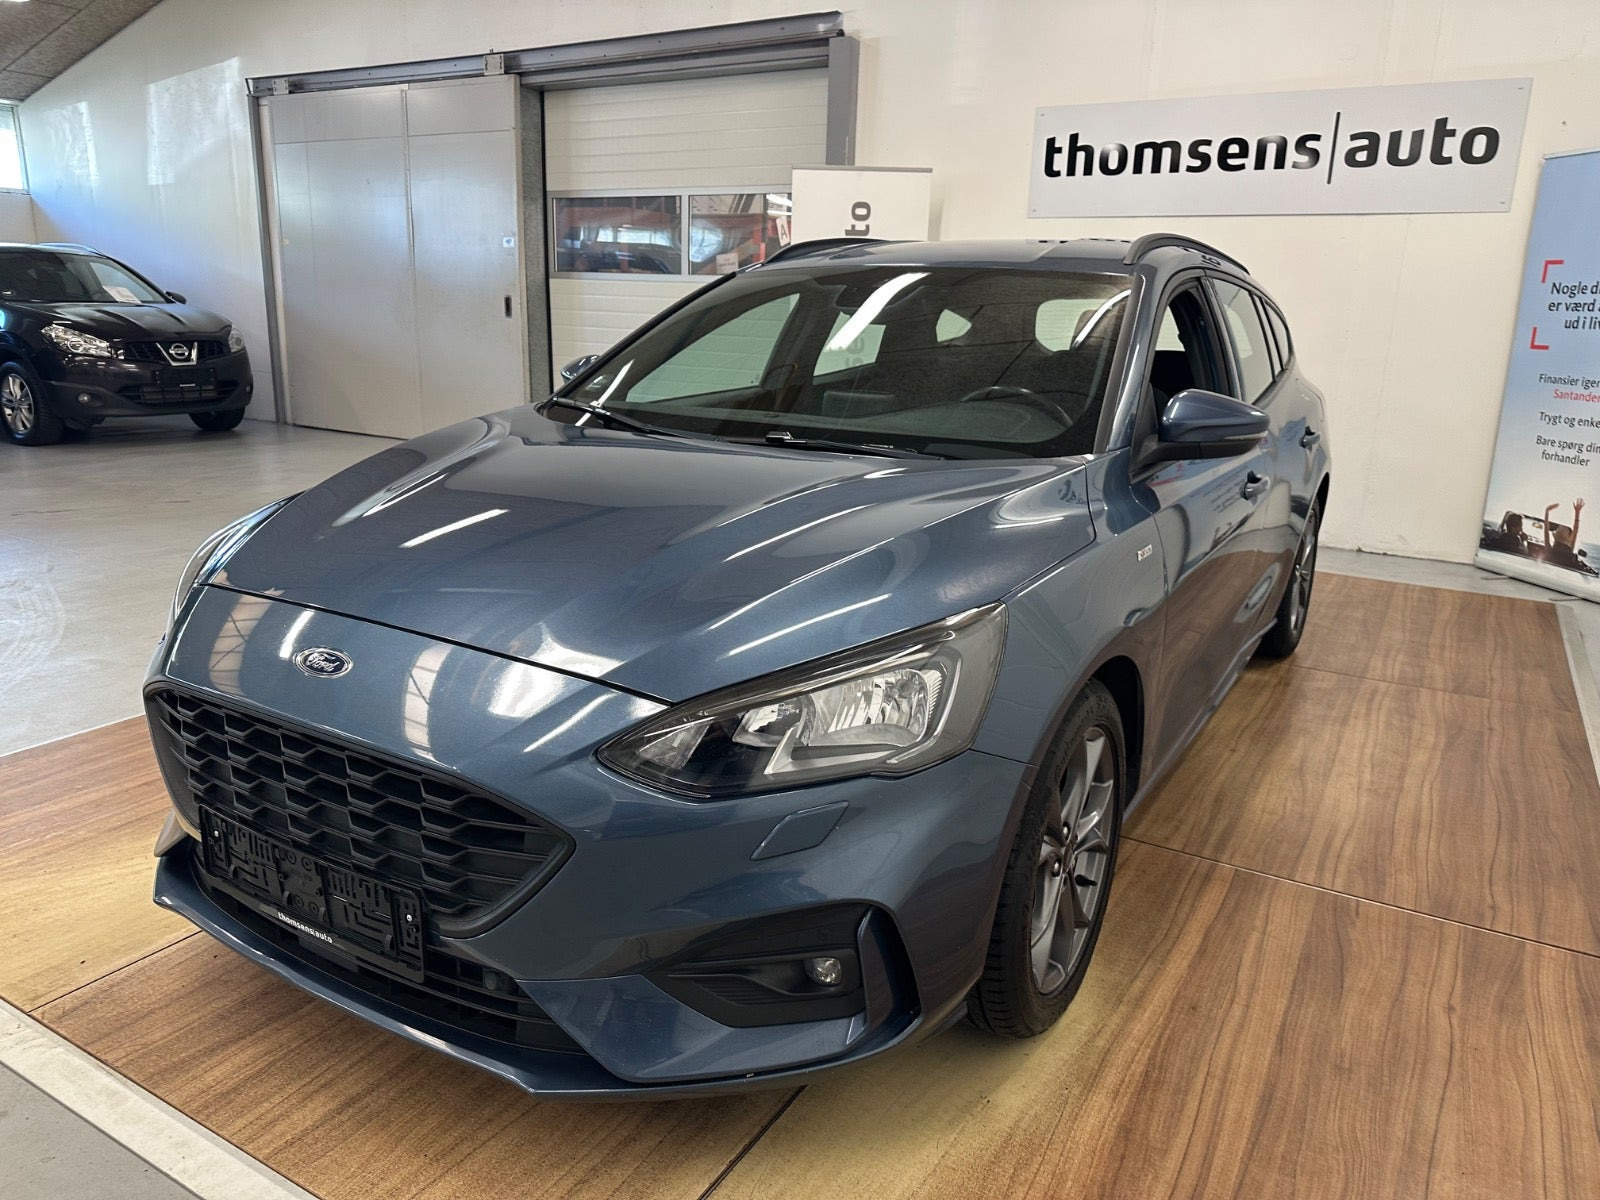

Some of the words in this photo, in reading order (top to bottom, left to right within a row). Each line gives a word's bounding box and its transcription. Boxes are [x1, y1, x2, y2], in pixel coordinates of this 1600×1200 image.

[1551, 281, 1588, 298] Nogle
[1590, 281, 1600, 294] d
[1548, 302, 1562, 312] er
[1565, 299, 1596, 312] værd
[1564, 316, 1580, 329] ud
[1582, 316, 1587, 330] i
[1539, 373, 1580, 386] Finansier
[1539, 412, 1562, 426] Trygt
[1563, 416, 1576, 428] og
[1536, 435, 1556, 447] Bare
[1541, 449, 1591, 466] forhandler
